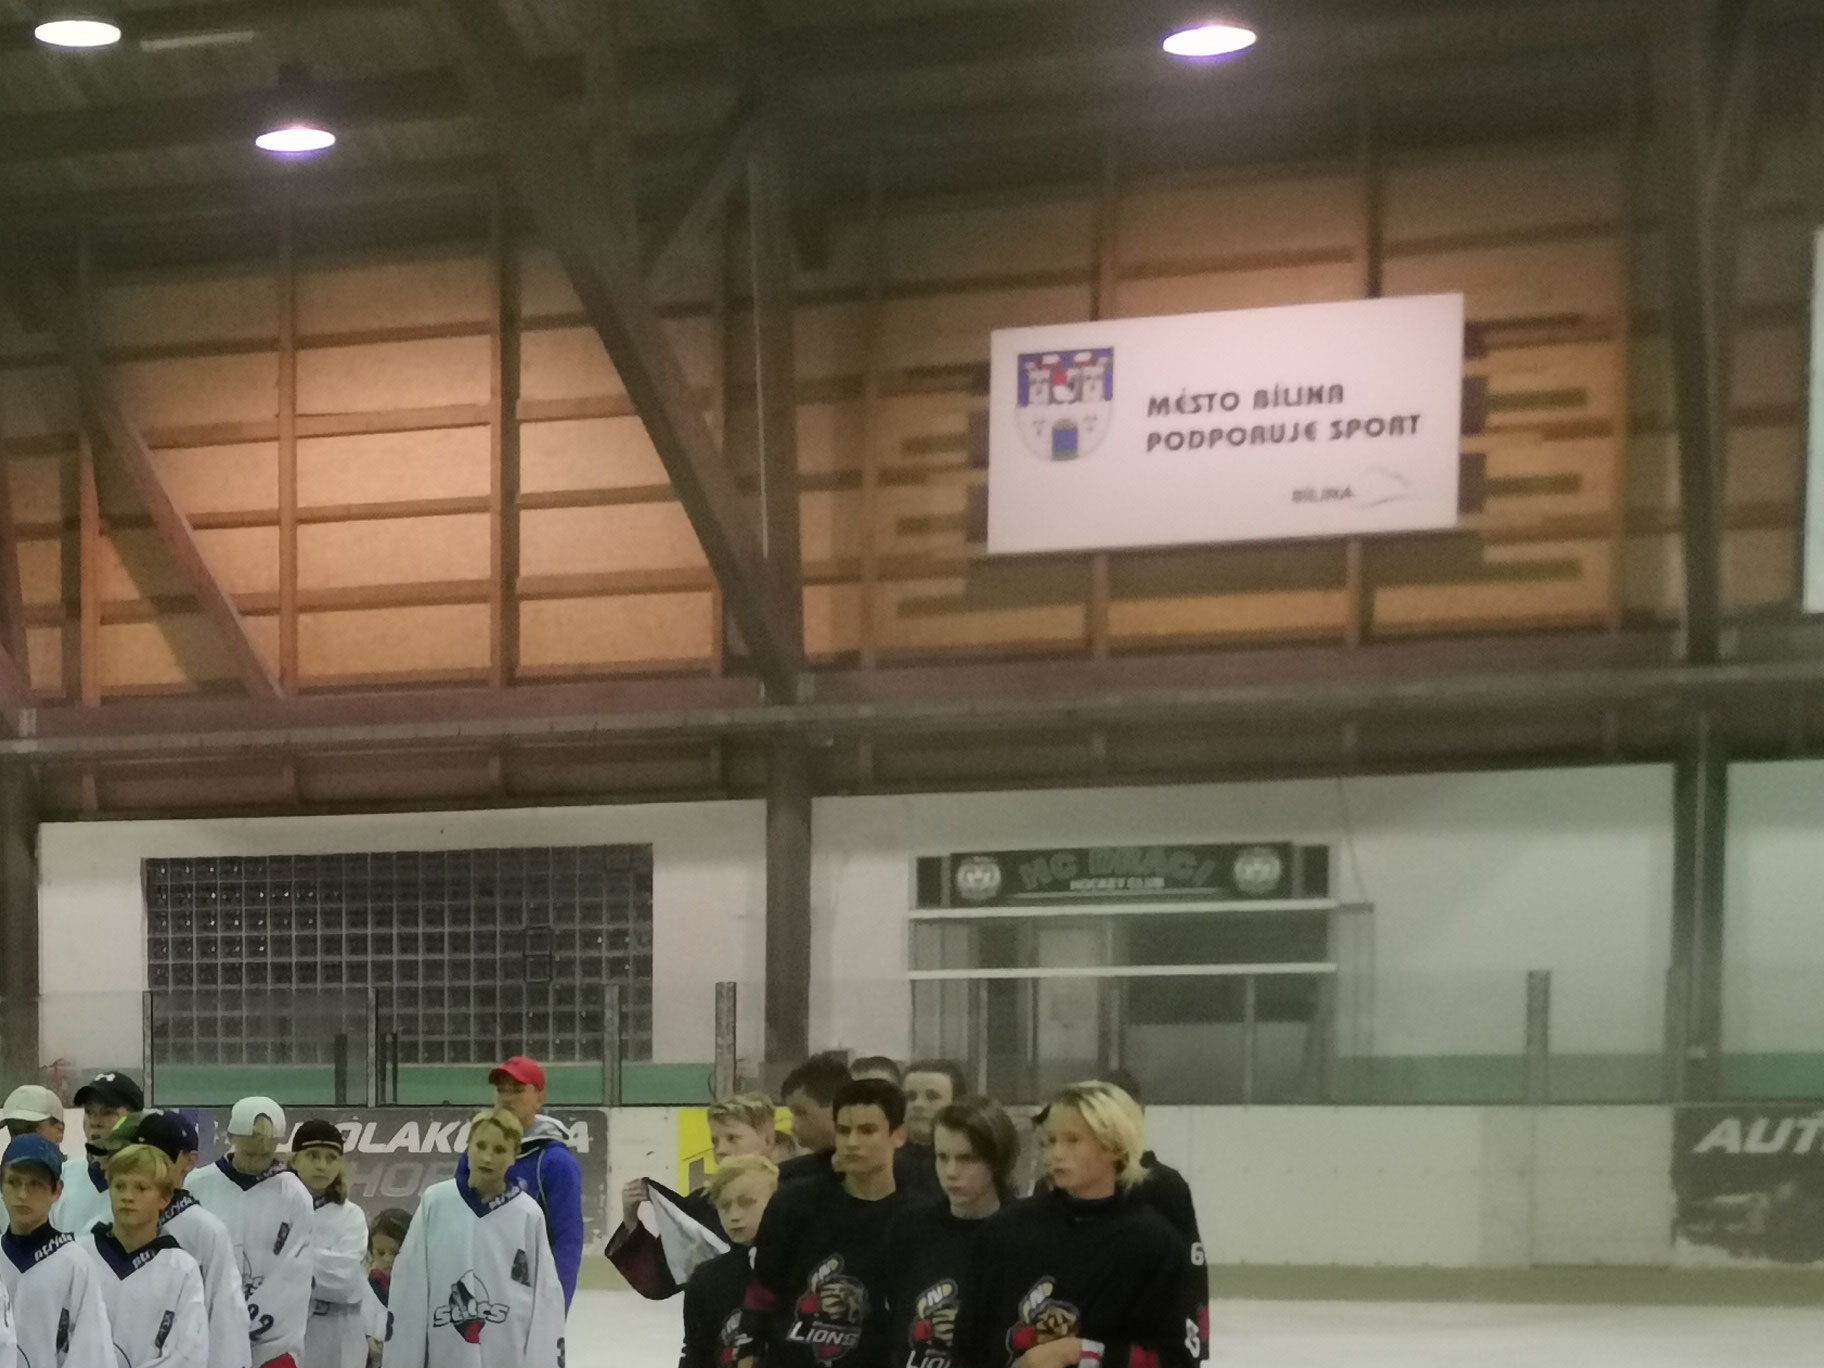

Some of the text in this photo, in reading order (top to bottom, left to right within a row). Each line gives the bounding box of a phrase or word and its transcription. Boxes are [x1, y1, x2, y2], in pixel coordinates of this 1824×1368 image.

[1147, 414, 1422, 453] PODPORUJE SPORT
[1692, 1117, 1824, 1154] AUT
